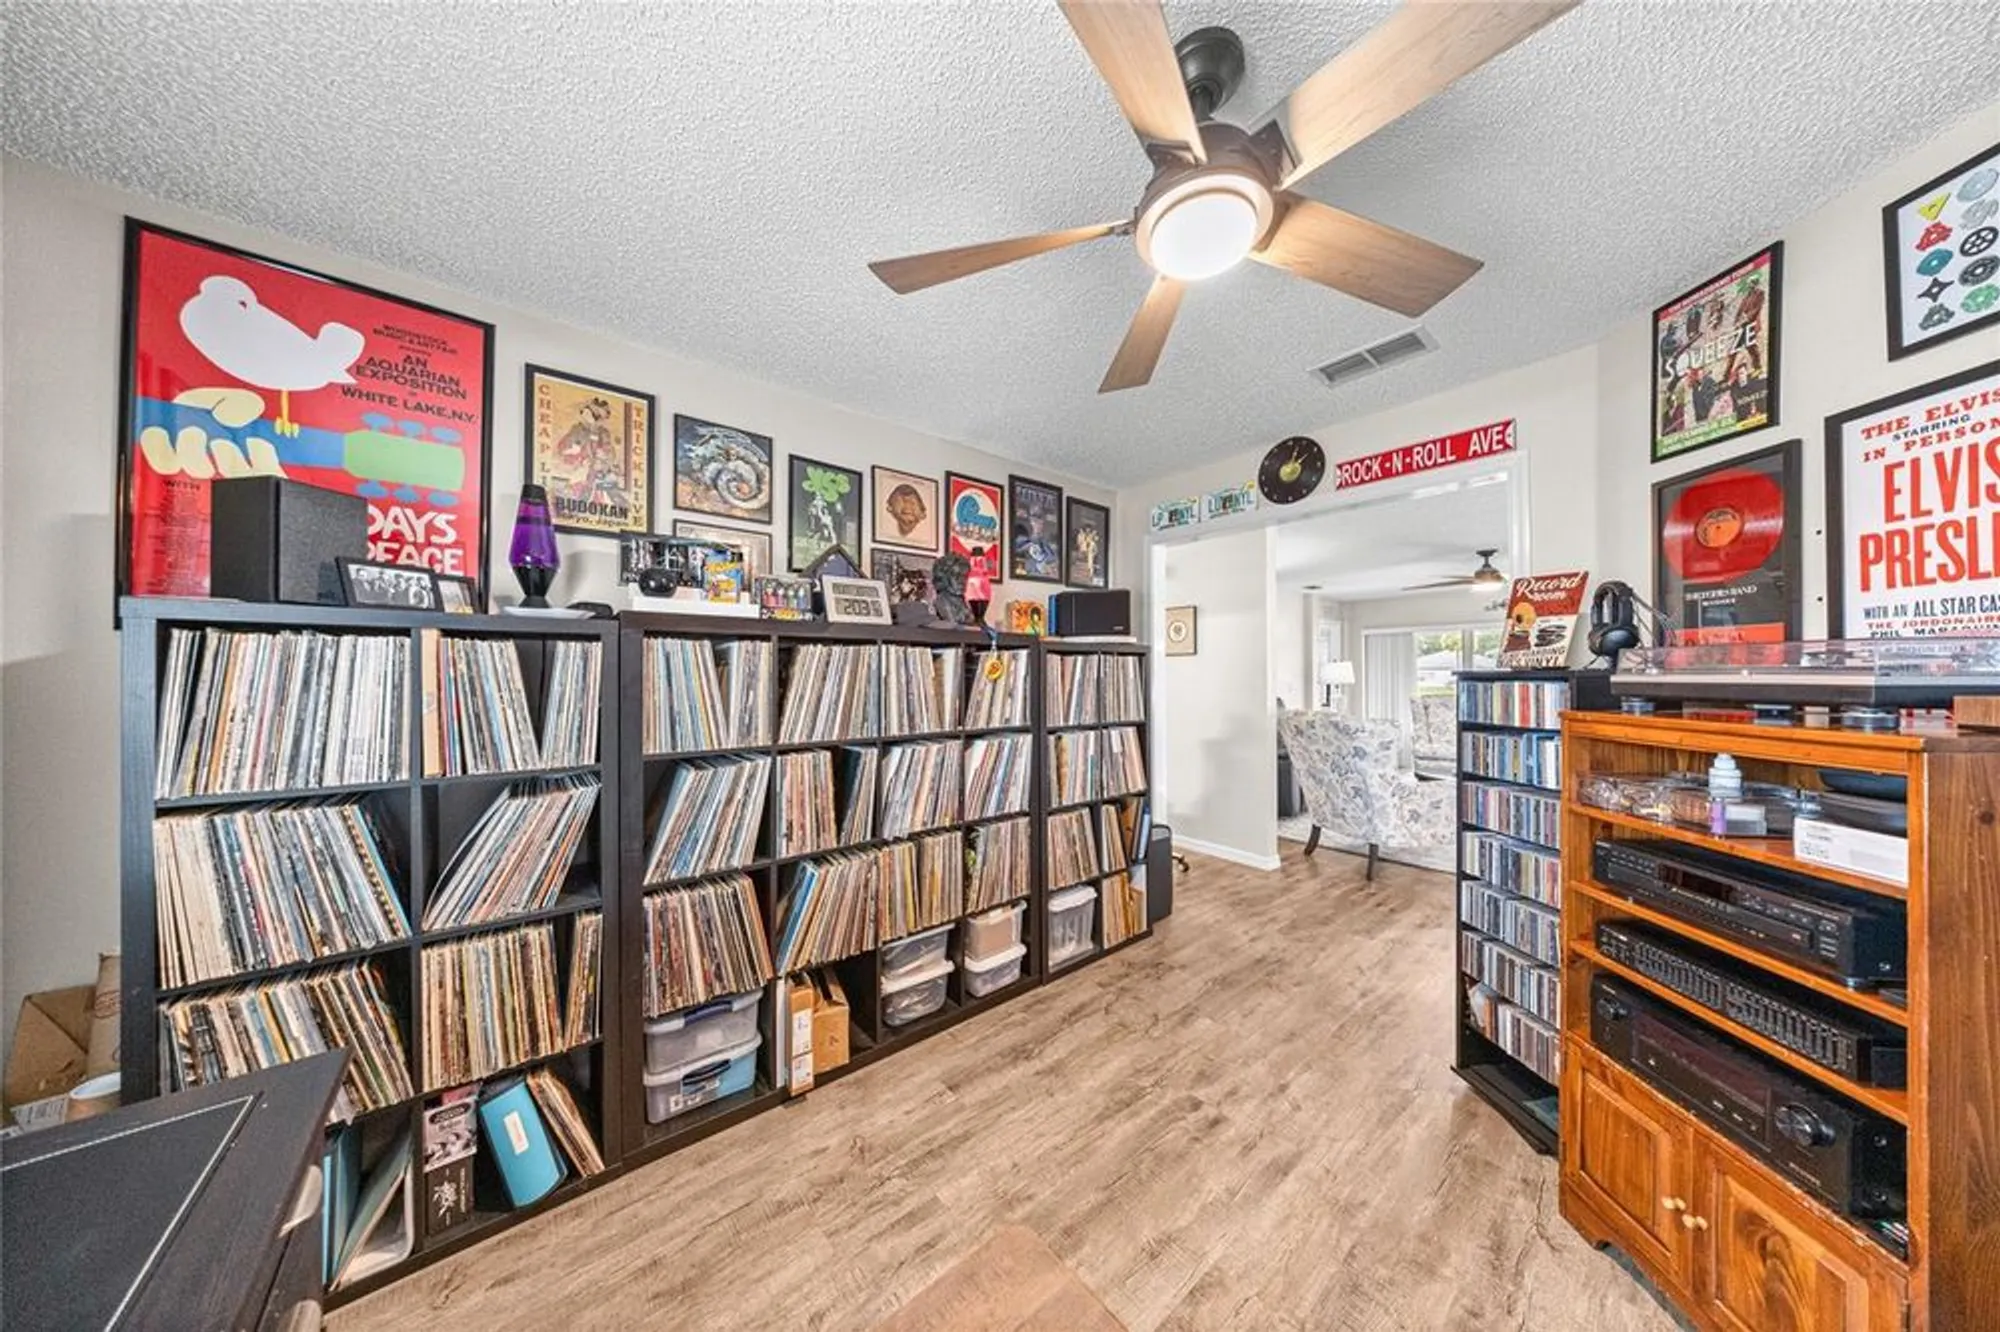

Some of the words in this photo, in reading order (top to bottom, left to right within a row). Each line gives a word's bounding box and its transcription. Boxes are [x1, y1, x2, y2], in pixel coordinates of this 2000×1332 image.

[365, 356, 461, 387] AQUARIAN
[403, 354, 428, 369] AN
[356, 365, 467, 399] EXPOSITION
[341, 385, 399, 407] WHITE
[1861, 415, 1910, 440] THE
[1892, 414, 1971, 441] STARRING
[1468, 425, 1504, 457] AVE
[1863, 447, 1886, 463] IN
[554, 496, 629, 521] BUDOKAN
[368, 503, 459, 545] DAYS
[1863, 606, 1888, 620] WITH
[1892, 604, 1908, 617] AN
[1913, 599, 1938, 618] ALL
[1940, 596, 1977, 616] STAR
[1979, 594, 2000, 613] CA
[1867, 621, 1893, 630] THE
